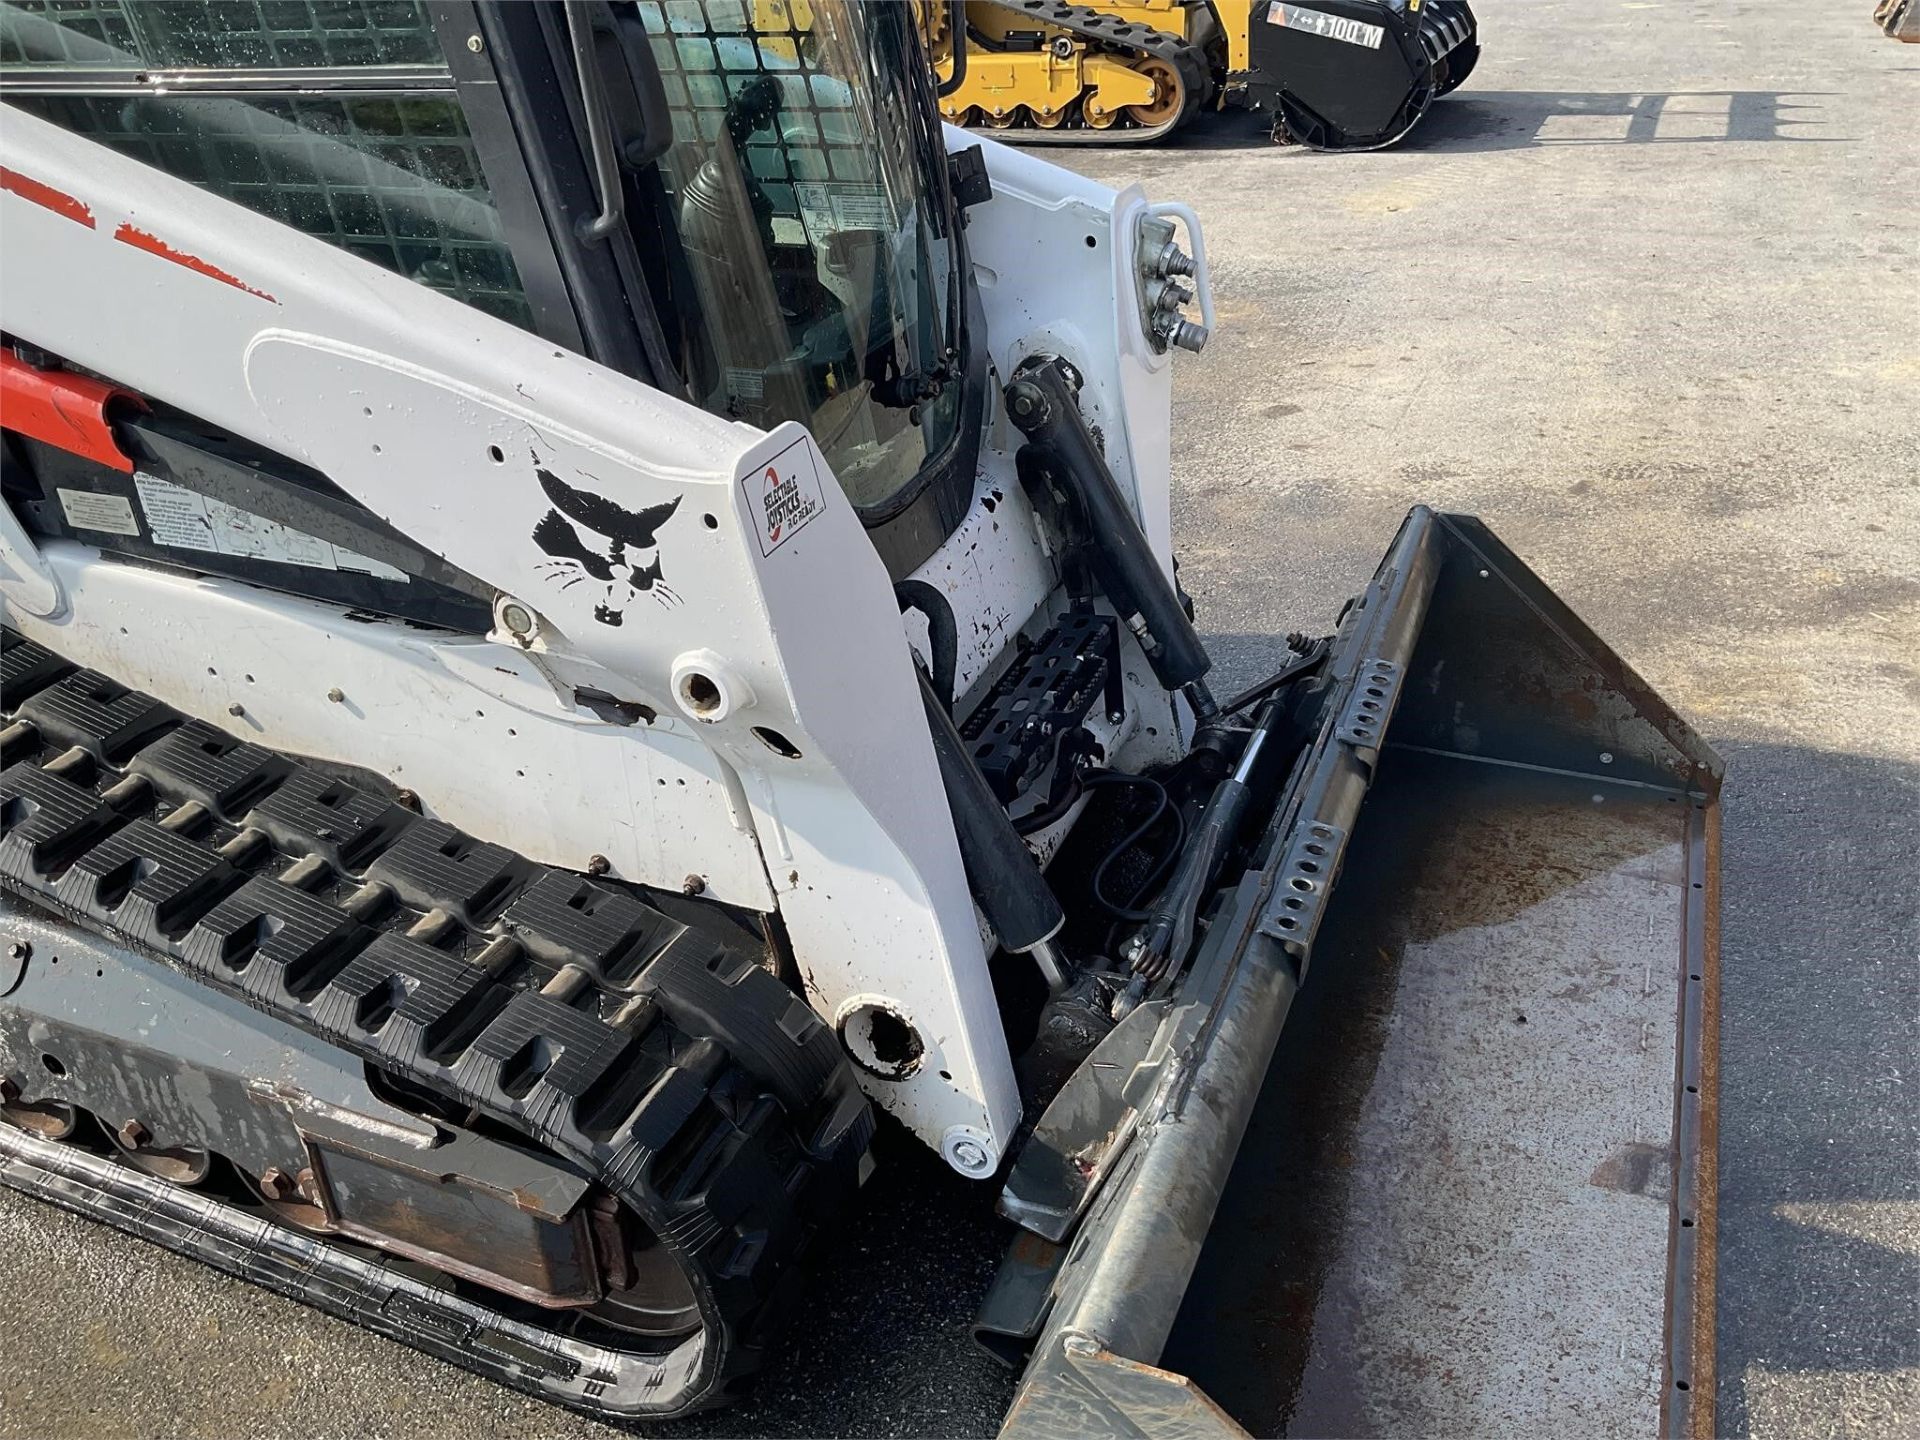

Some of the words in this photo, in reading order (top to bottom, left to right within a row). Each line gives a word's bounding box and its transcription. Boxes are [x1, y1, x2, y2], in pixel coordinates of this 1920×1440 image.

[1327, 16, 1358, 43] 100
[1363, 24, 1385, 49] M
[764, 474, 798, 512] SELECTABLE
[766, 490, 801, 533] JOYSTICKS
